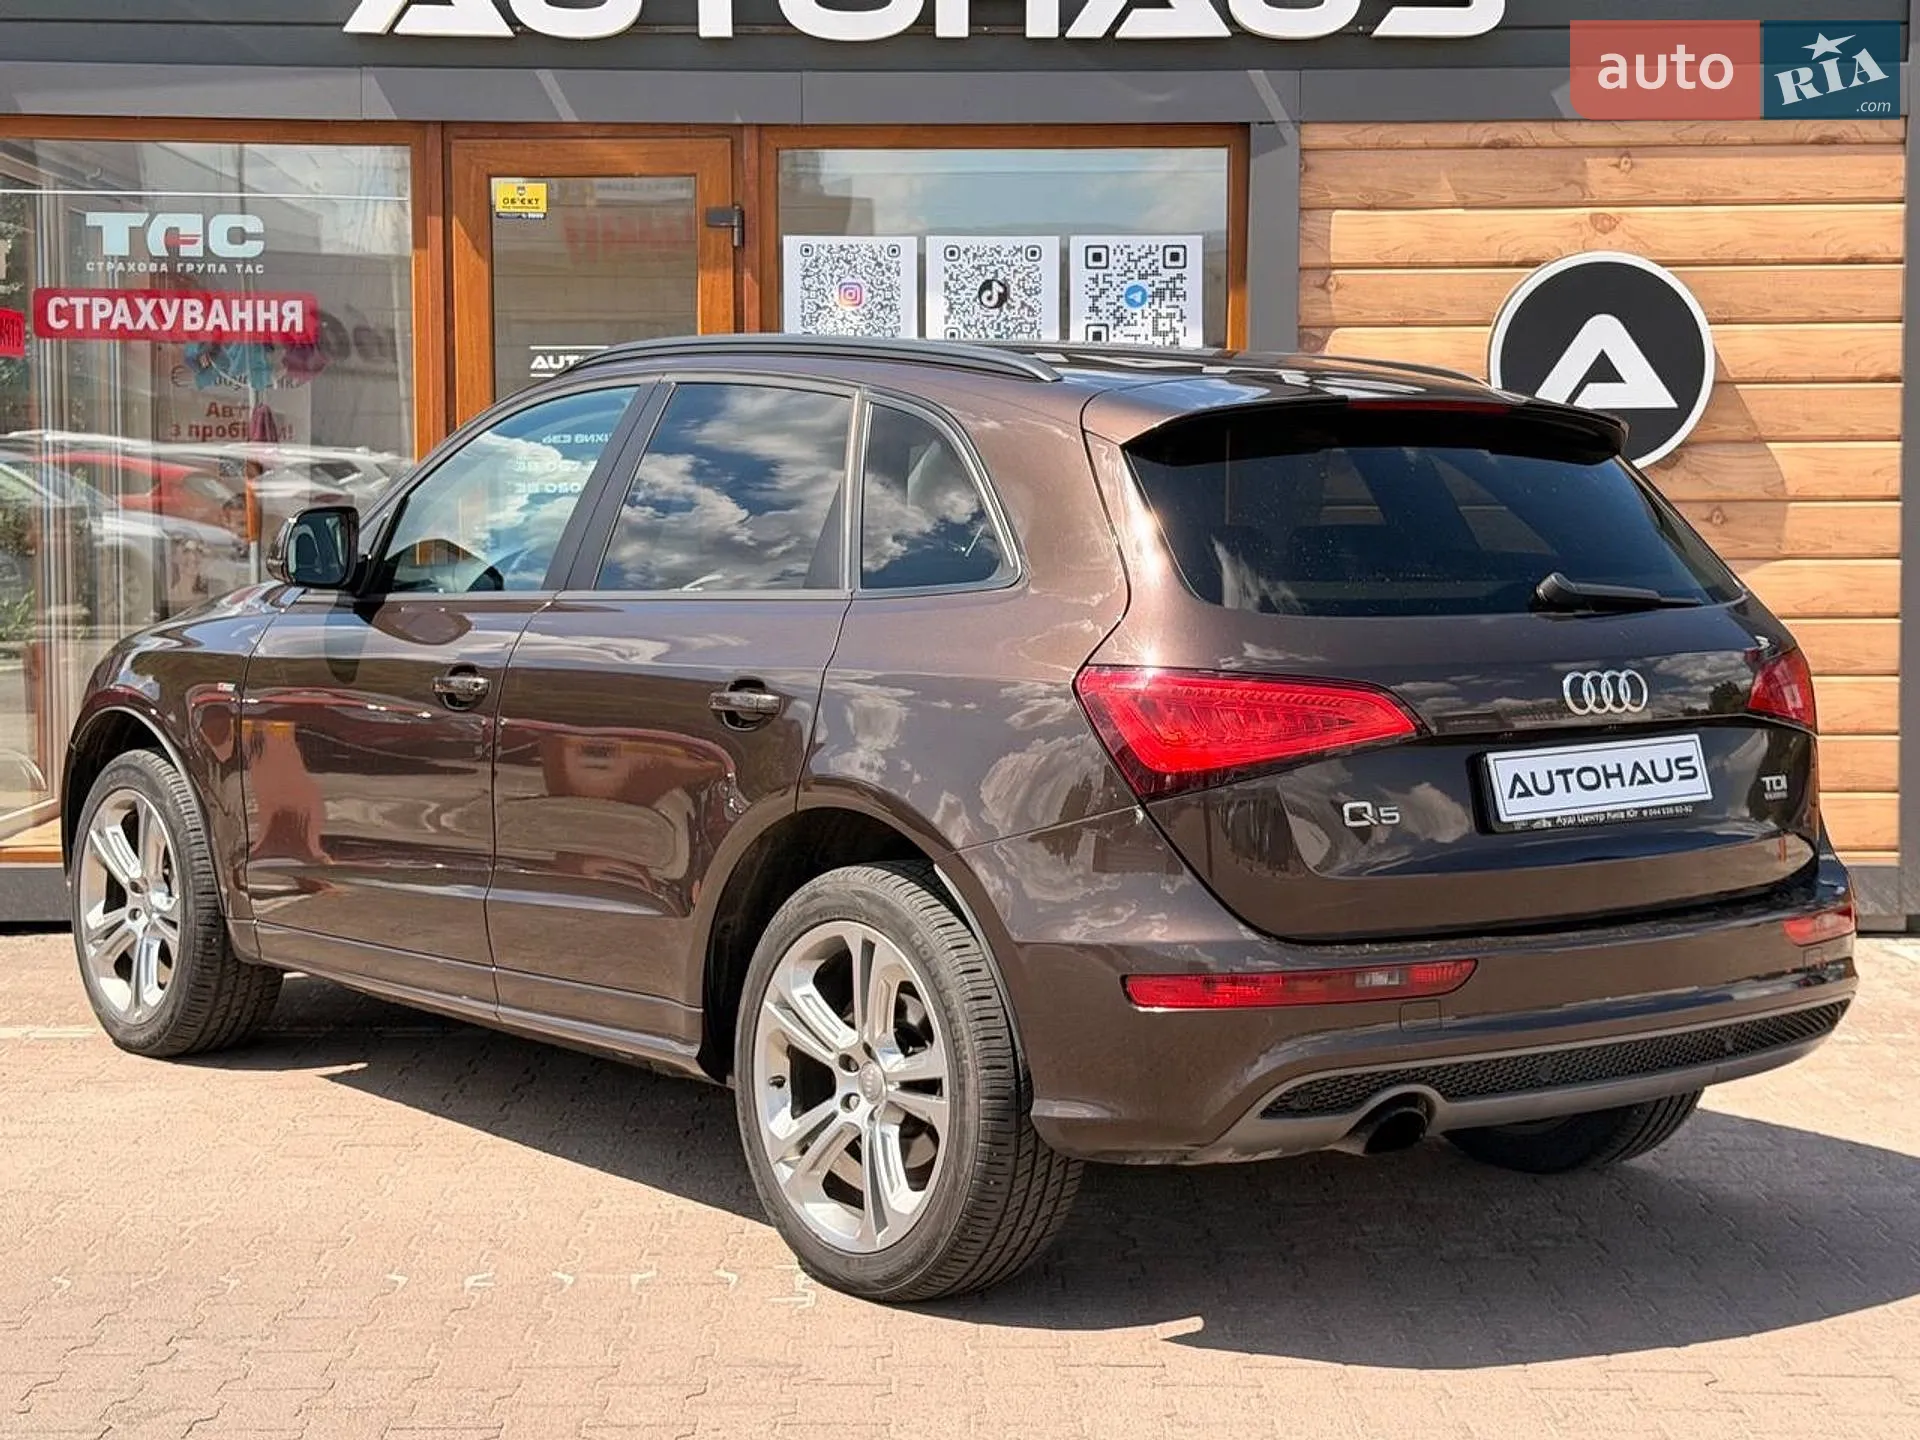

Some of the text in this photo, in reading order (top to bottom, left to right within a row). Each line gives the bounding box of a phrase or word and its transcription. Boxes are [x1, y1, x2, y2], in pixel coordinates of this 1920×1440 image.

[85, 211, 265, 258] ТАС
[86, 261, 264, 274] СТРАХОВА ГРУПА ТАС
[47, 296, 304, 333] СТРАХУВАННЯ
[529, 355, 584, 370] AUT
[1508, 756, 1698, 799] AUTOHAUS
[1761, 774, 1787, 791] TDI
[1343, 801, 1400, 827] Q5
